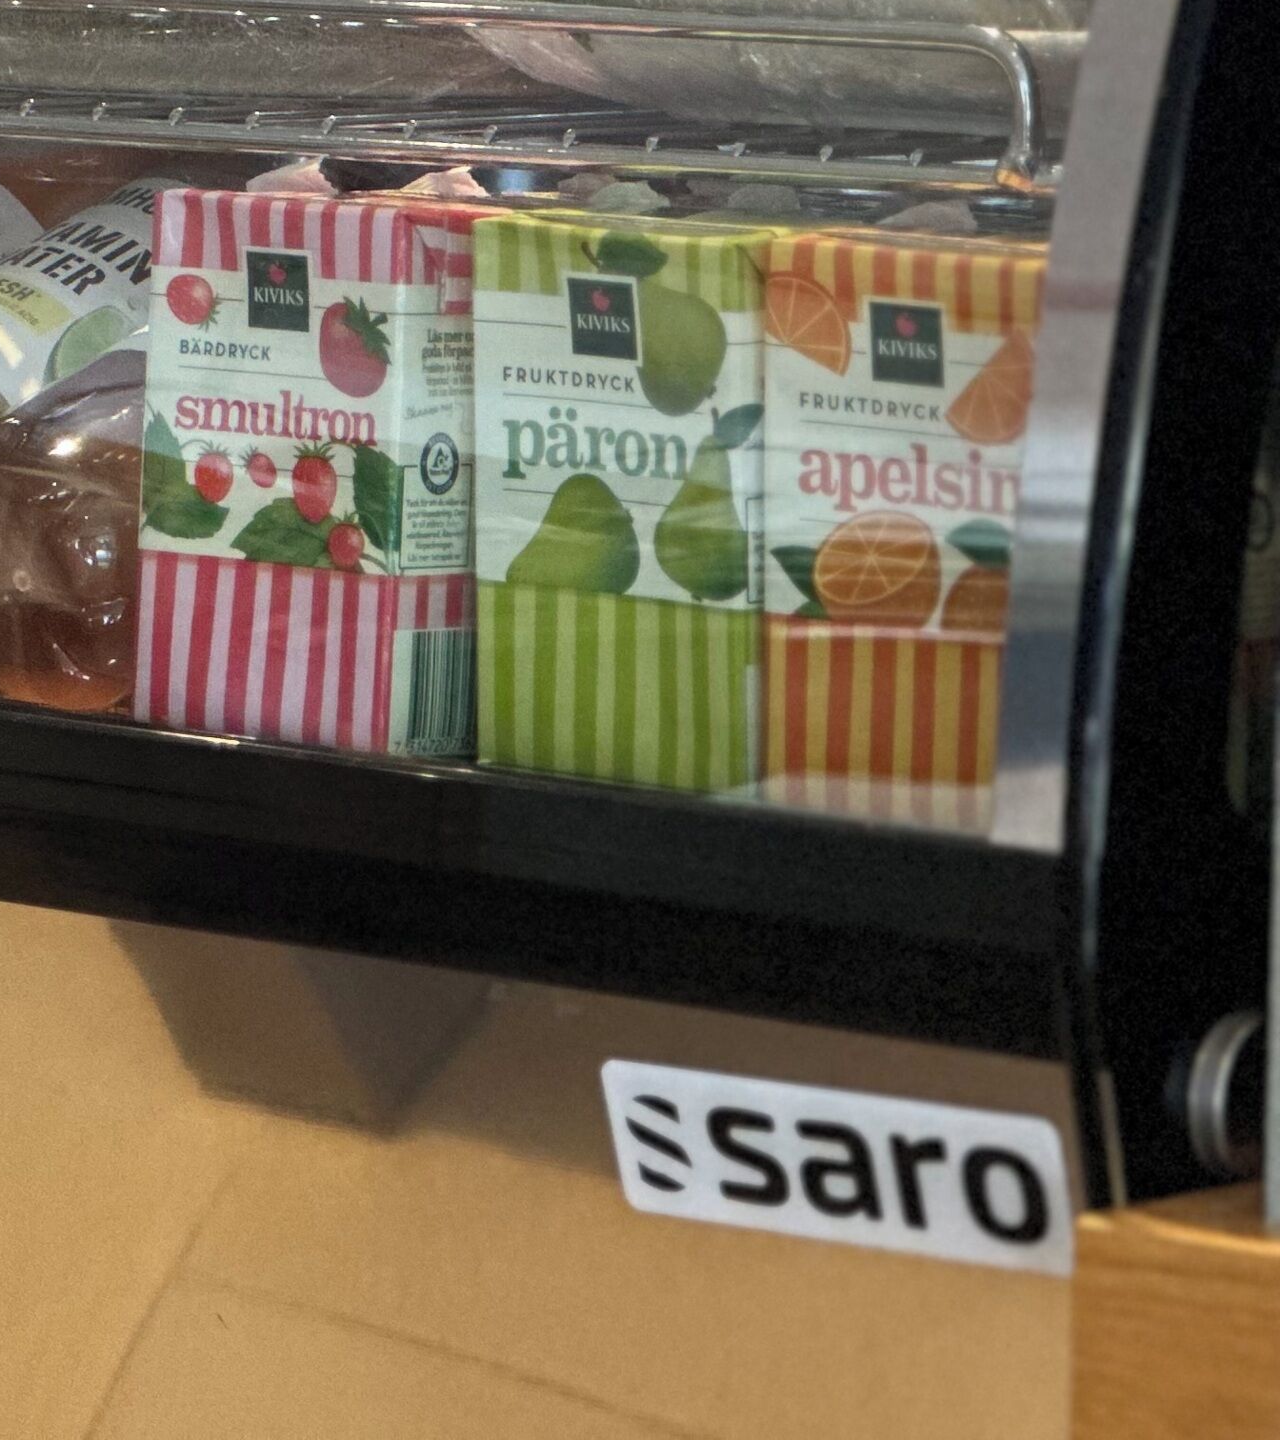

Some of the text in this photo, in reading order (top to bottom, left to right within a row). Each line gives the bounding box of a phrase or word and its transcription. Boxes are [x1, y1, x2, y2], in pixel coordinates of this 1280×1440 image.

[252, 286, 305, 307] KIVIKS
[575, 312, 632, 334] KIVIKS
[178, 337, 272, 362] BÄRDRYCK
[877, 338, 938, 361] KIVIKS
[502, 365, 635, 393] FRUKTDRYCK
[174, 389, 378, 447] smultron
[799, 391, 941, 422] FRUKTDRYCK
[502, 406, 688, 481] päron
[797, 442, 1021, 515] apelsin
[705, 1106, 1050, 1245] saro
